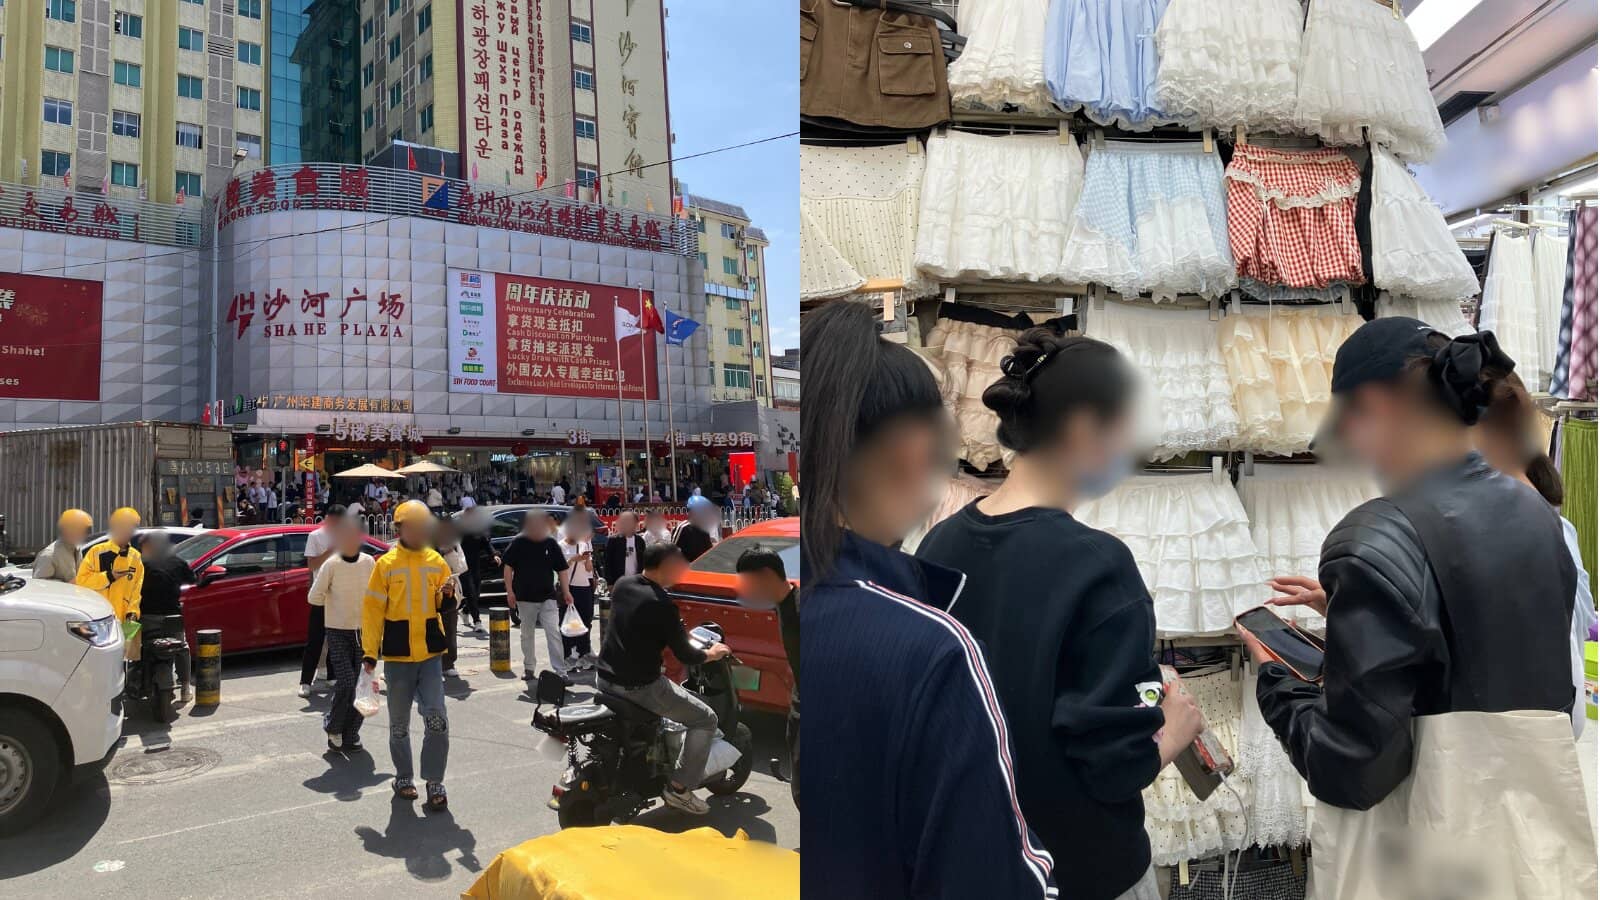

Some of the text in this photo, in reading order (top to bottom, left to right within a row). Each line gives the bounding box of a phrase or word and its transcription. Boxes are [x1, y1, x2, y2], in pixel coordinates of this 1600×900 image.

[513, 110, 524, 175] одежды
[65, 225, 120, 240] CENTER
[263, 287, 405, 321] 沙河广场
[505, 282, 591, 309] 周年庆活动
[506, 304, 596, 319] Anniversary Celebration
[340, 323, 404, 338] PLAZA
[507, 314, 584, 333] 拿货现金抵扣
[507, 328, 526, 337] Cash
[527, 329, 560, 340] Discount
[571, 332, 608, 343] Purchases
[1, 345, 46, 357] Shahe!
[507, 338, 595, 357] 拿货抽奖派现金
[507, 351, 610, 366] Lucky Draw with Cash Prizes
[506, 361, 626, 382] 外国友人专属幸运红包
[272, 394, 413, 413] 广州华建商务发展有限公司
[333, 421, 424, 443] 5楼美食城
[567, 429, 592, 445] 3街
[701, 431, 753, 447] 5至9街
